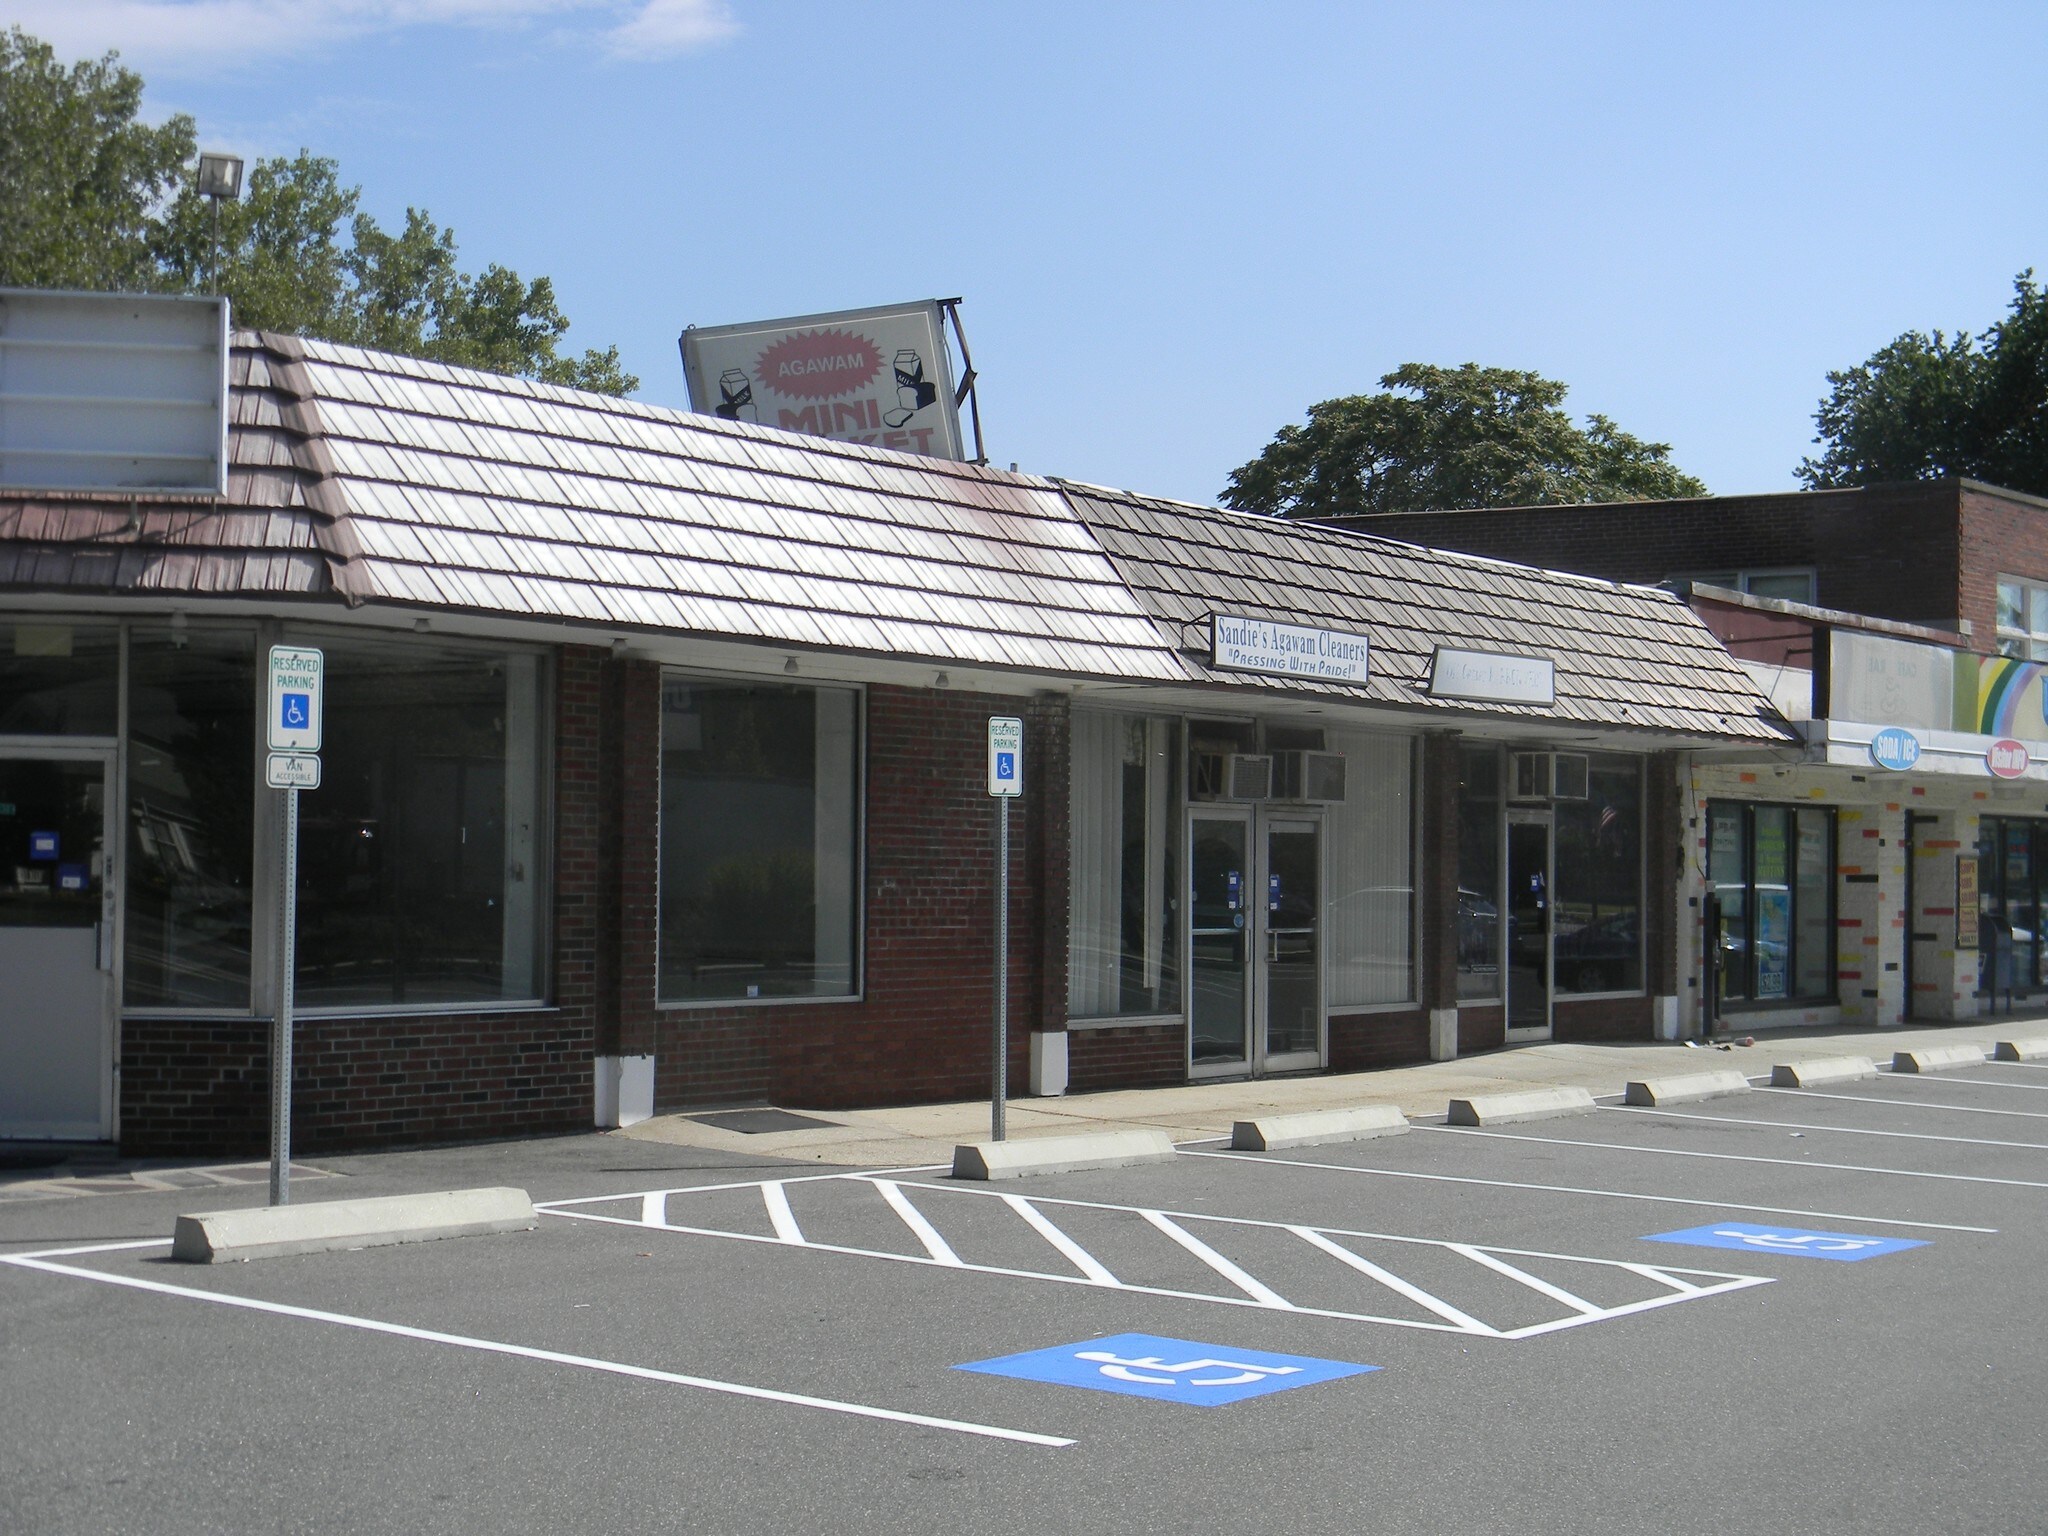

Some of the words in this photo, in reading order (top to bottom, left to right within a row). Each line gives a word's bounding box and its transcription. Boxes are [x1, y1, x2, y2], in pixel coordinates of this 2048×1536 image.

[778, 353, 864, 378] AGAWAM
[778, 399, 881, 435] MINI
[1218, 617, 1268, 648] Sandie's
[1271, 625, 1316, 656] Agawam
[1319, 631, 1365, 662] Cleaners
[273, 657, 319, 672] RESERVED
[277, 675, 315, 690] PARKING
[991, 725, 1019, 736] RESERVED
[994, 738, 1017, 749] PARKING
[286, 761, 303, 772] VAN
[276, 772, 312, 781] ACCESSIBLE
